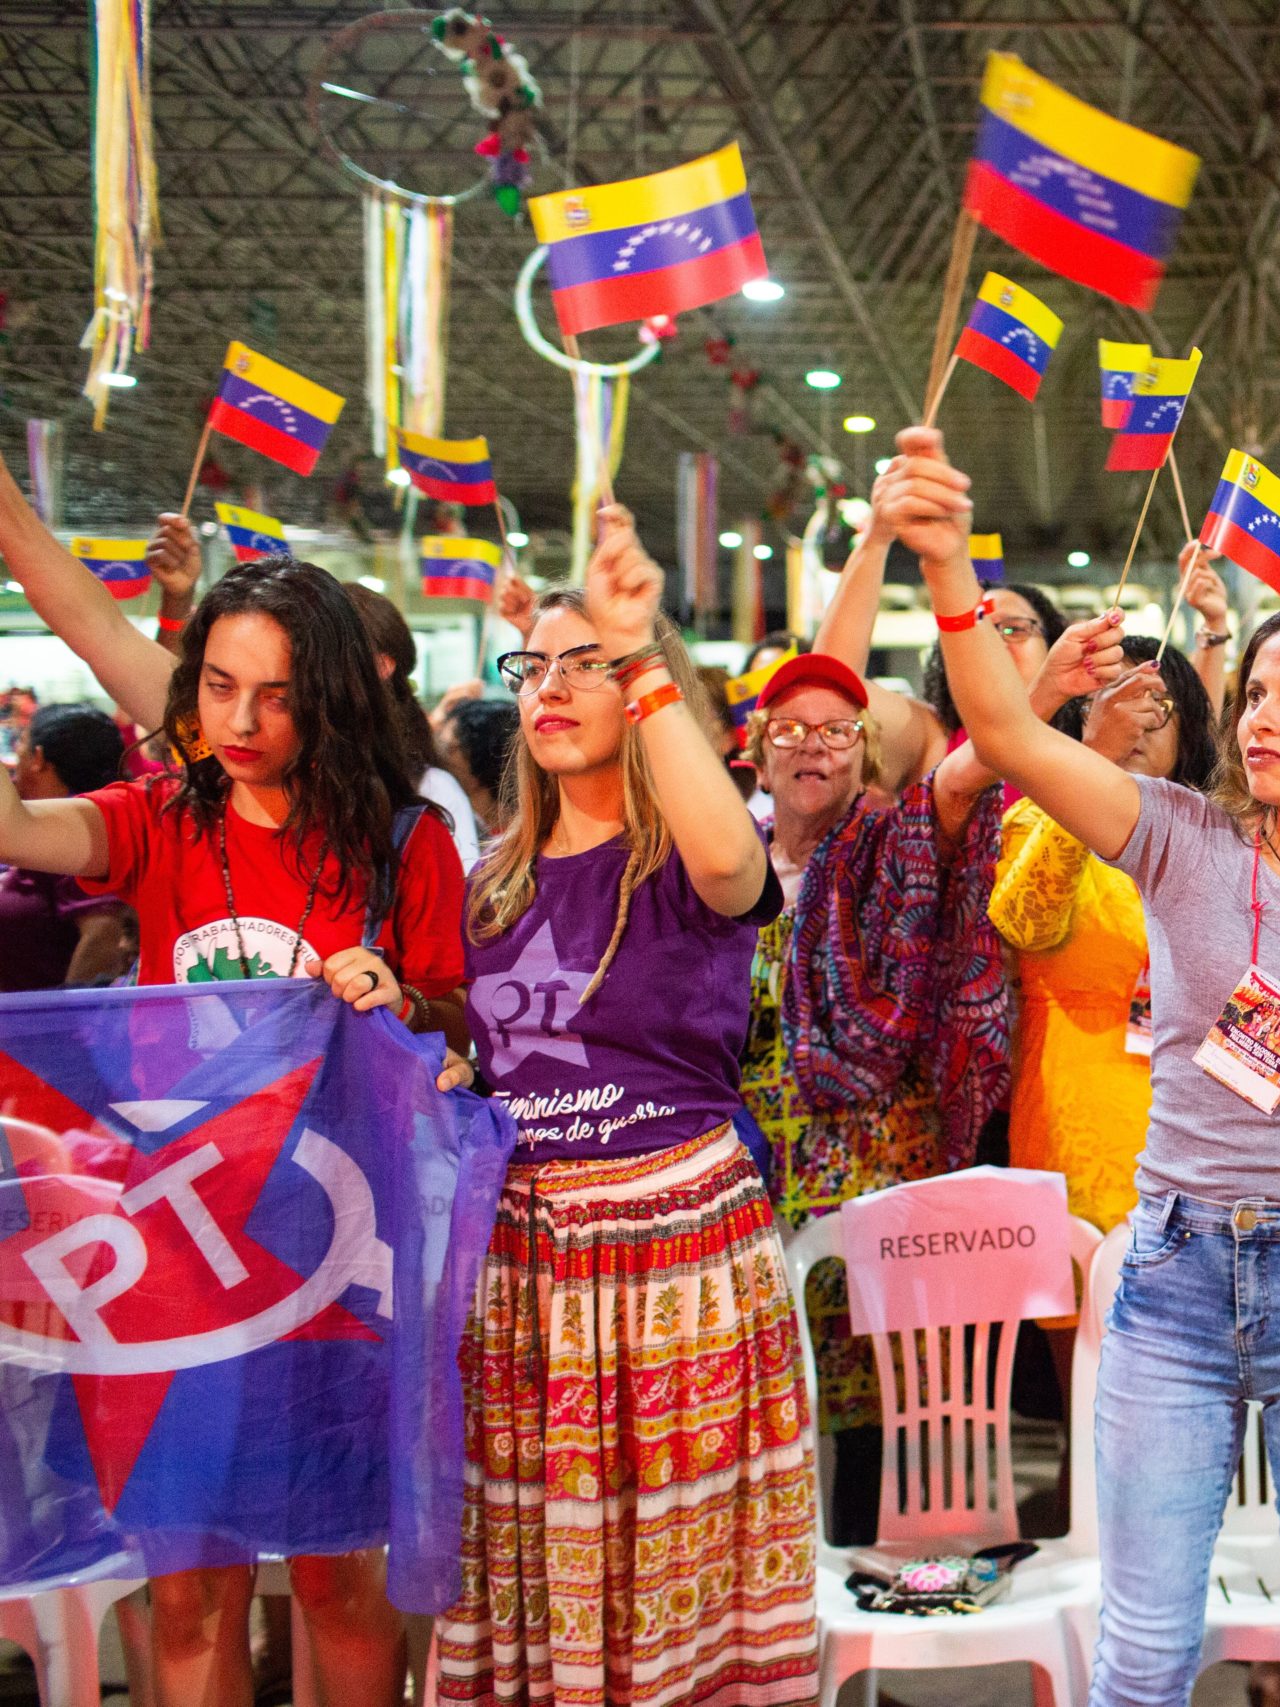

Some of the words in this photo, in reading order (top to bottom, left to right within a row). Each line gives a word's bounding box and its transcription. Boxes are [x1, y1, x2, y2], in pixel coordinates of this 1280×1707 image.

[490, 979, 570, 1048] PT
[566, 1115, 595, 1142] de
[22, 1141, 250, 1345] PT
[879, 1224, 1037, 1260] RESERVADO
